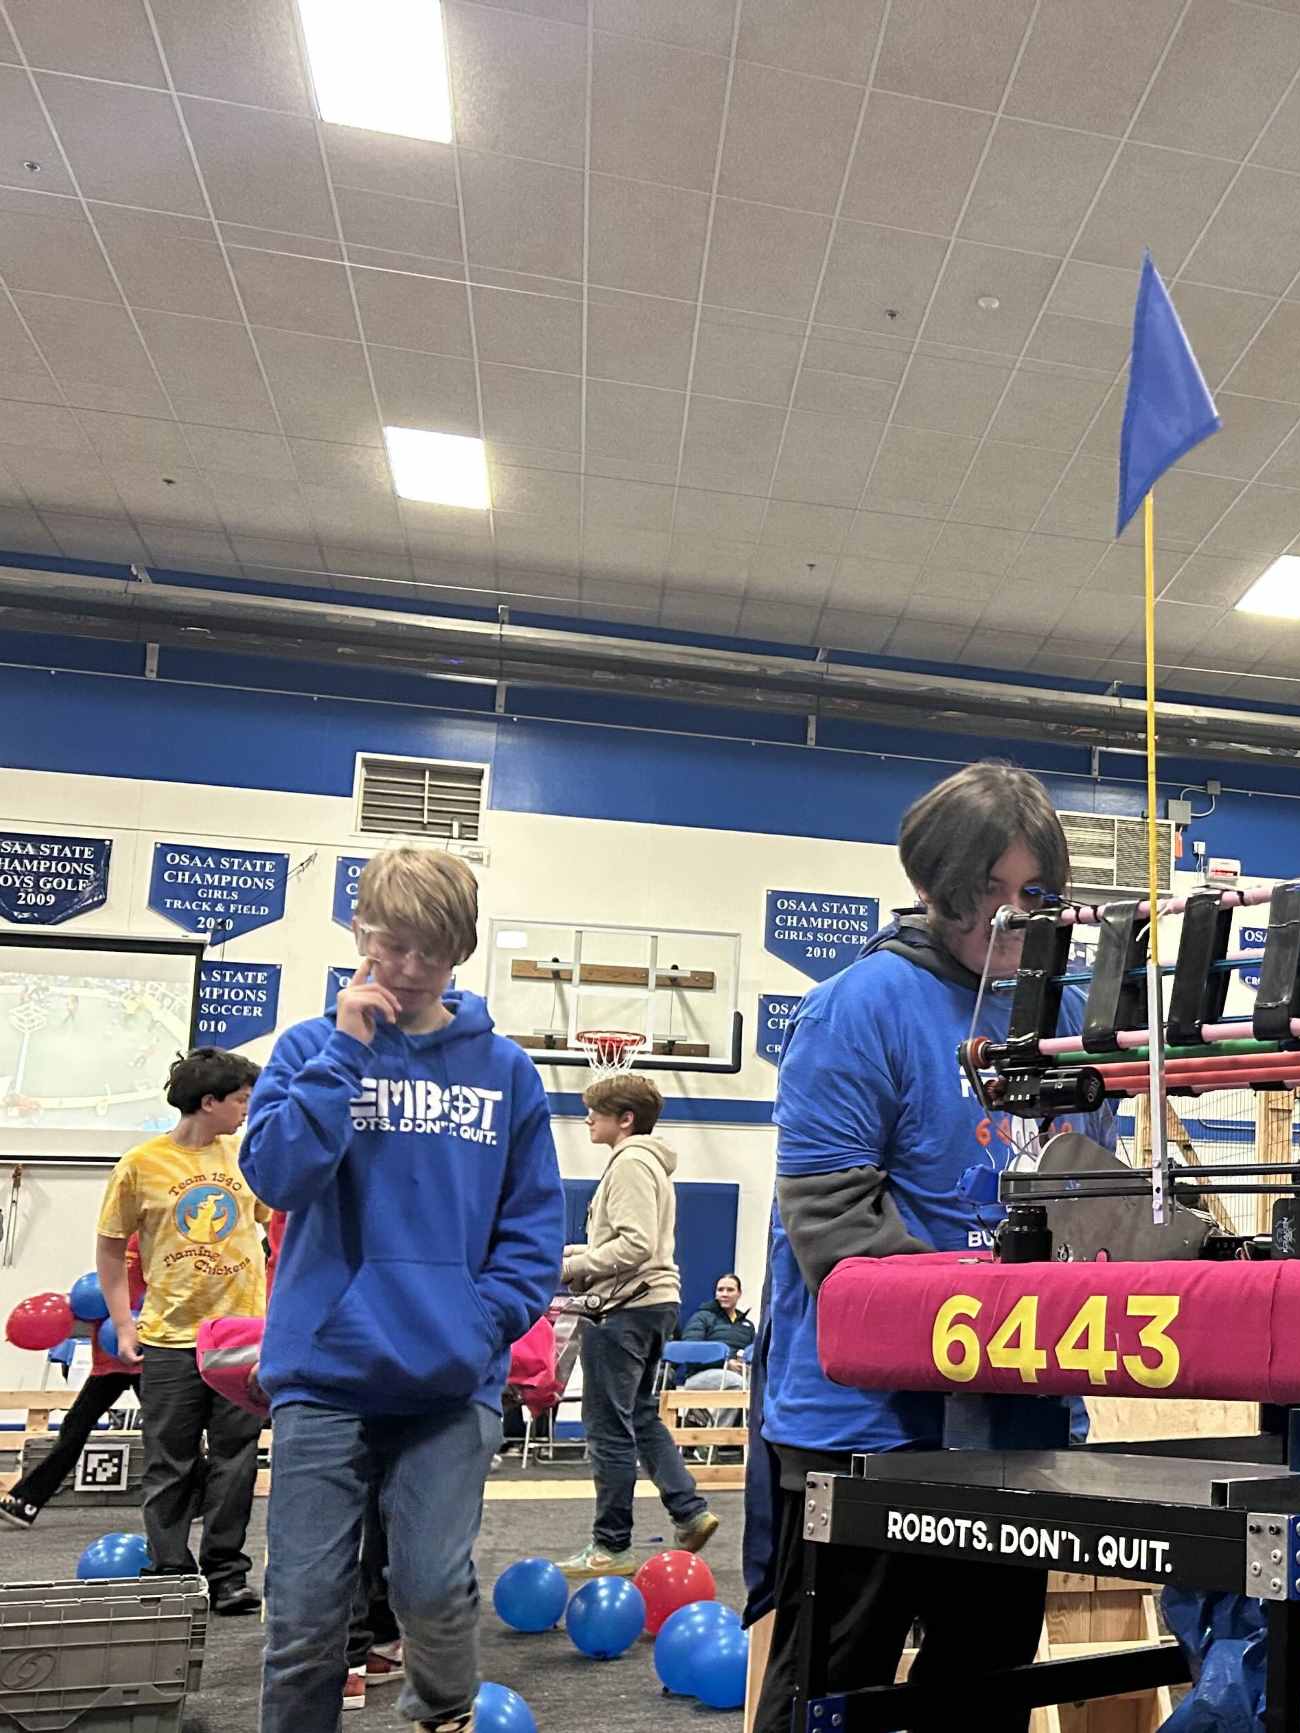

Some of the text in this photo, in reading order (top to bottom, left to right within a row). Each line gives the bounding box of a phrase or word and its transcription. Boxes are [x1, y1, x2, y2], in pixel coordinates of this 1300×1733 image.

[0, 841, 95, 859] SAA STATE
[0, 857, 95, 875] HAMPIONS
[166, 852, 276, 873] OSAA STATE
[0, 874, 89, 891] OYS GOLF
[163, 870, 275, 891] CHAMPIONS
[17, 892, 56, 906] 2009
[197, 889, 239, 900] GIRLS
[164, 899, 269, 915] TRACK & FIELD
[776, 898, 868, 916] OSAA STATE
[775, 914, 868, 932] CHAMPIONS
[774, 929, 868, 945] GIRLS SOCCER
[806, 946, 836, 959] 2010
[211, 969, 268, 985] STATE
[200, 986, 267, 1003] MPIONS
[200, 1003, 263, 1017] SOCCER
[199, 1019, 227, 1033] 010
[352, 1118, 395, 1132] OTS.
[460, 1127, 497, 1145] QUIT.
[168, 1172, 242, 1197] Team 1540
[163, 1246, 221, 1268] Flaming
[194, 1256, 251, 1276] Chickens
[931, 1294, 1181, 1389] 6443
[887, 1511, 993, 1552] ROBOTS.
[1097, 1535, 1173, 1574] QUIT.
